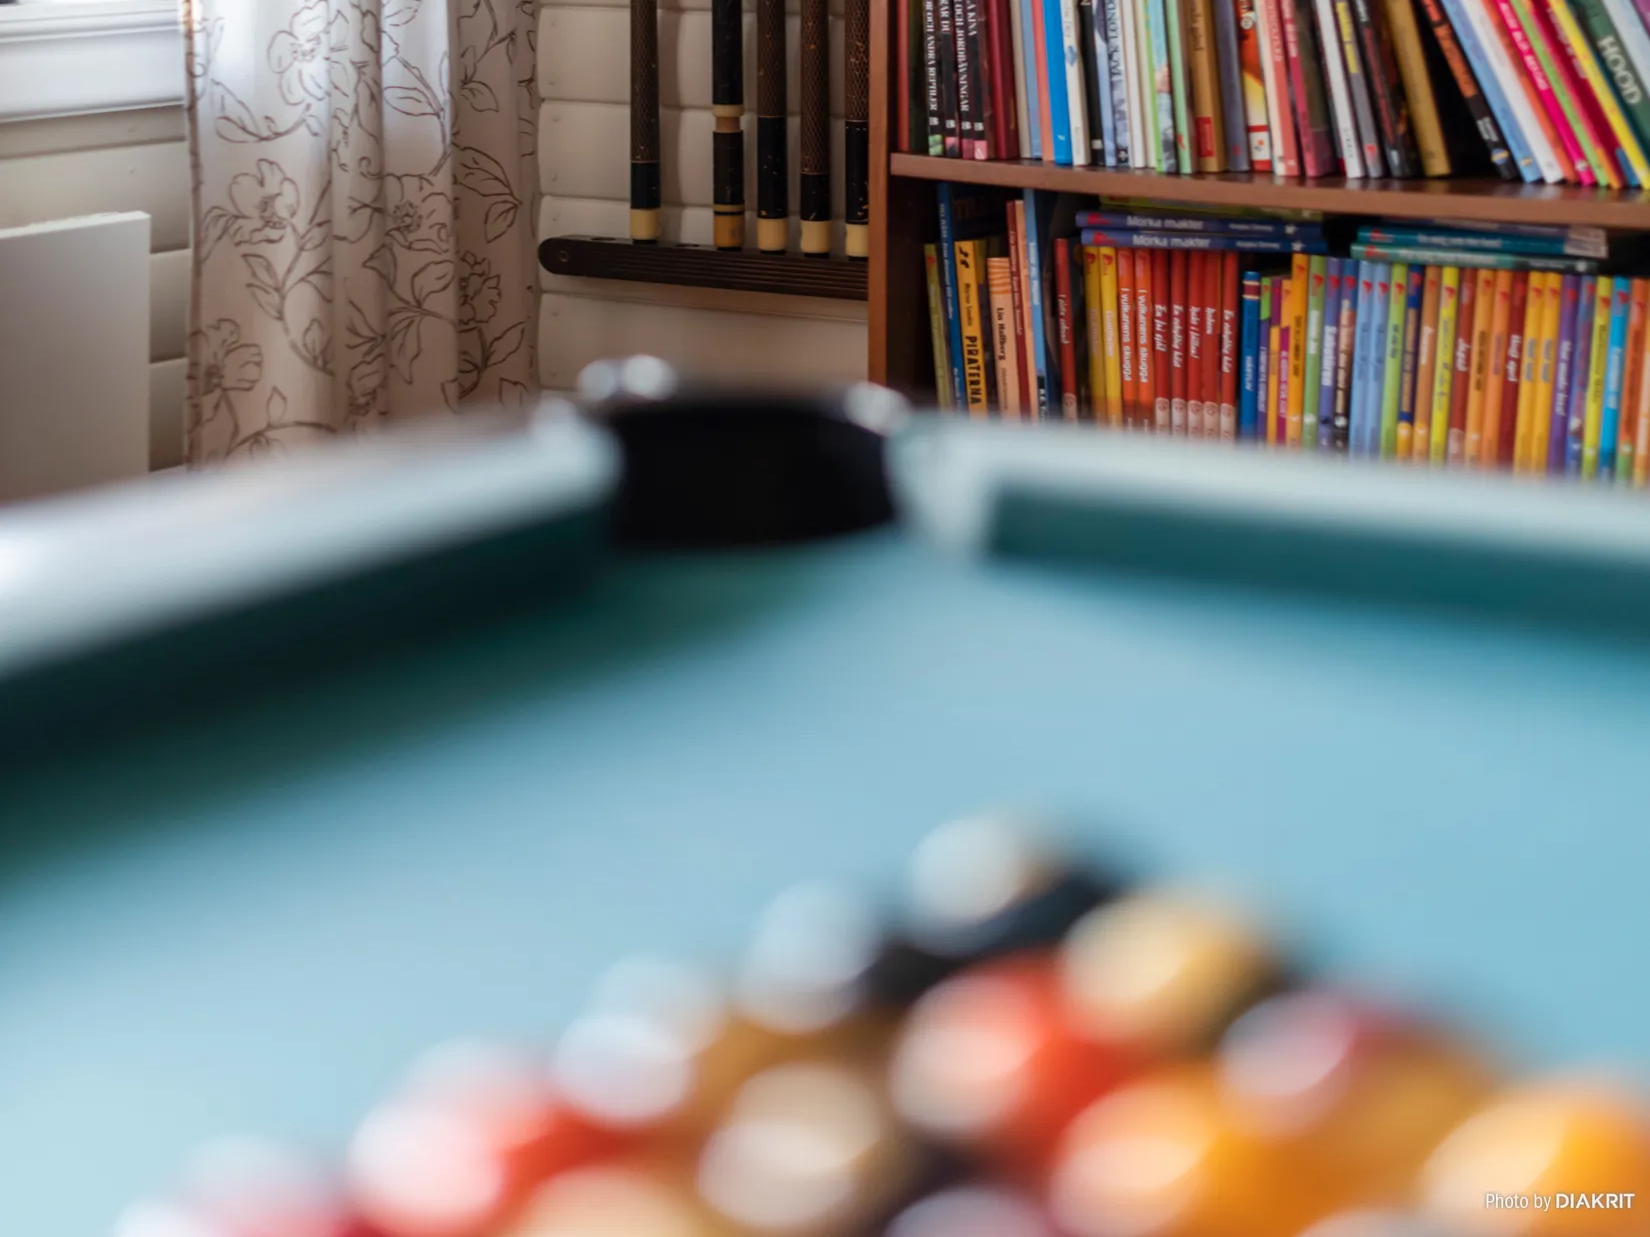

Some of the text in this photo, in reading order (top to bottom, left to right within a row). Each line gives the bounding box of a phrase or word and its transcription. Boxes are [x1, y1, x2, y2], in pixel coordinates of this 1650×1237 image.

[928, 66, 938, 110] REPTILER
[1597, 35, 1643, 105] HOOD
[1164, 216, 1204, 230] makter
[1171, 235, 1211, 248] makter
[1121, 294, 1132, 343] vulkanens
[1138, 295, 1149, 345] vulkanens
[998, 323, 1008, 361] Hallberg
[965, 335, 983, 405] PIRATERNA
[1123, 345, 1133, 382] skugga
[1139, 347, 1150, 383] skugga
